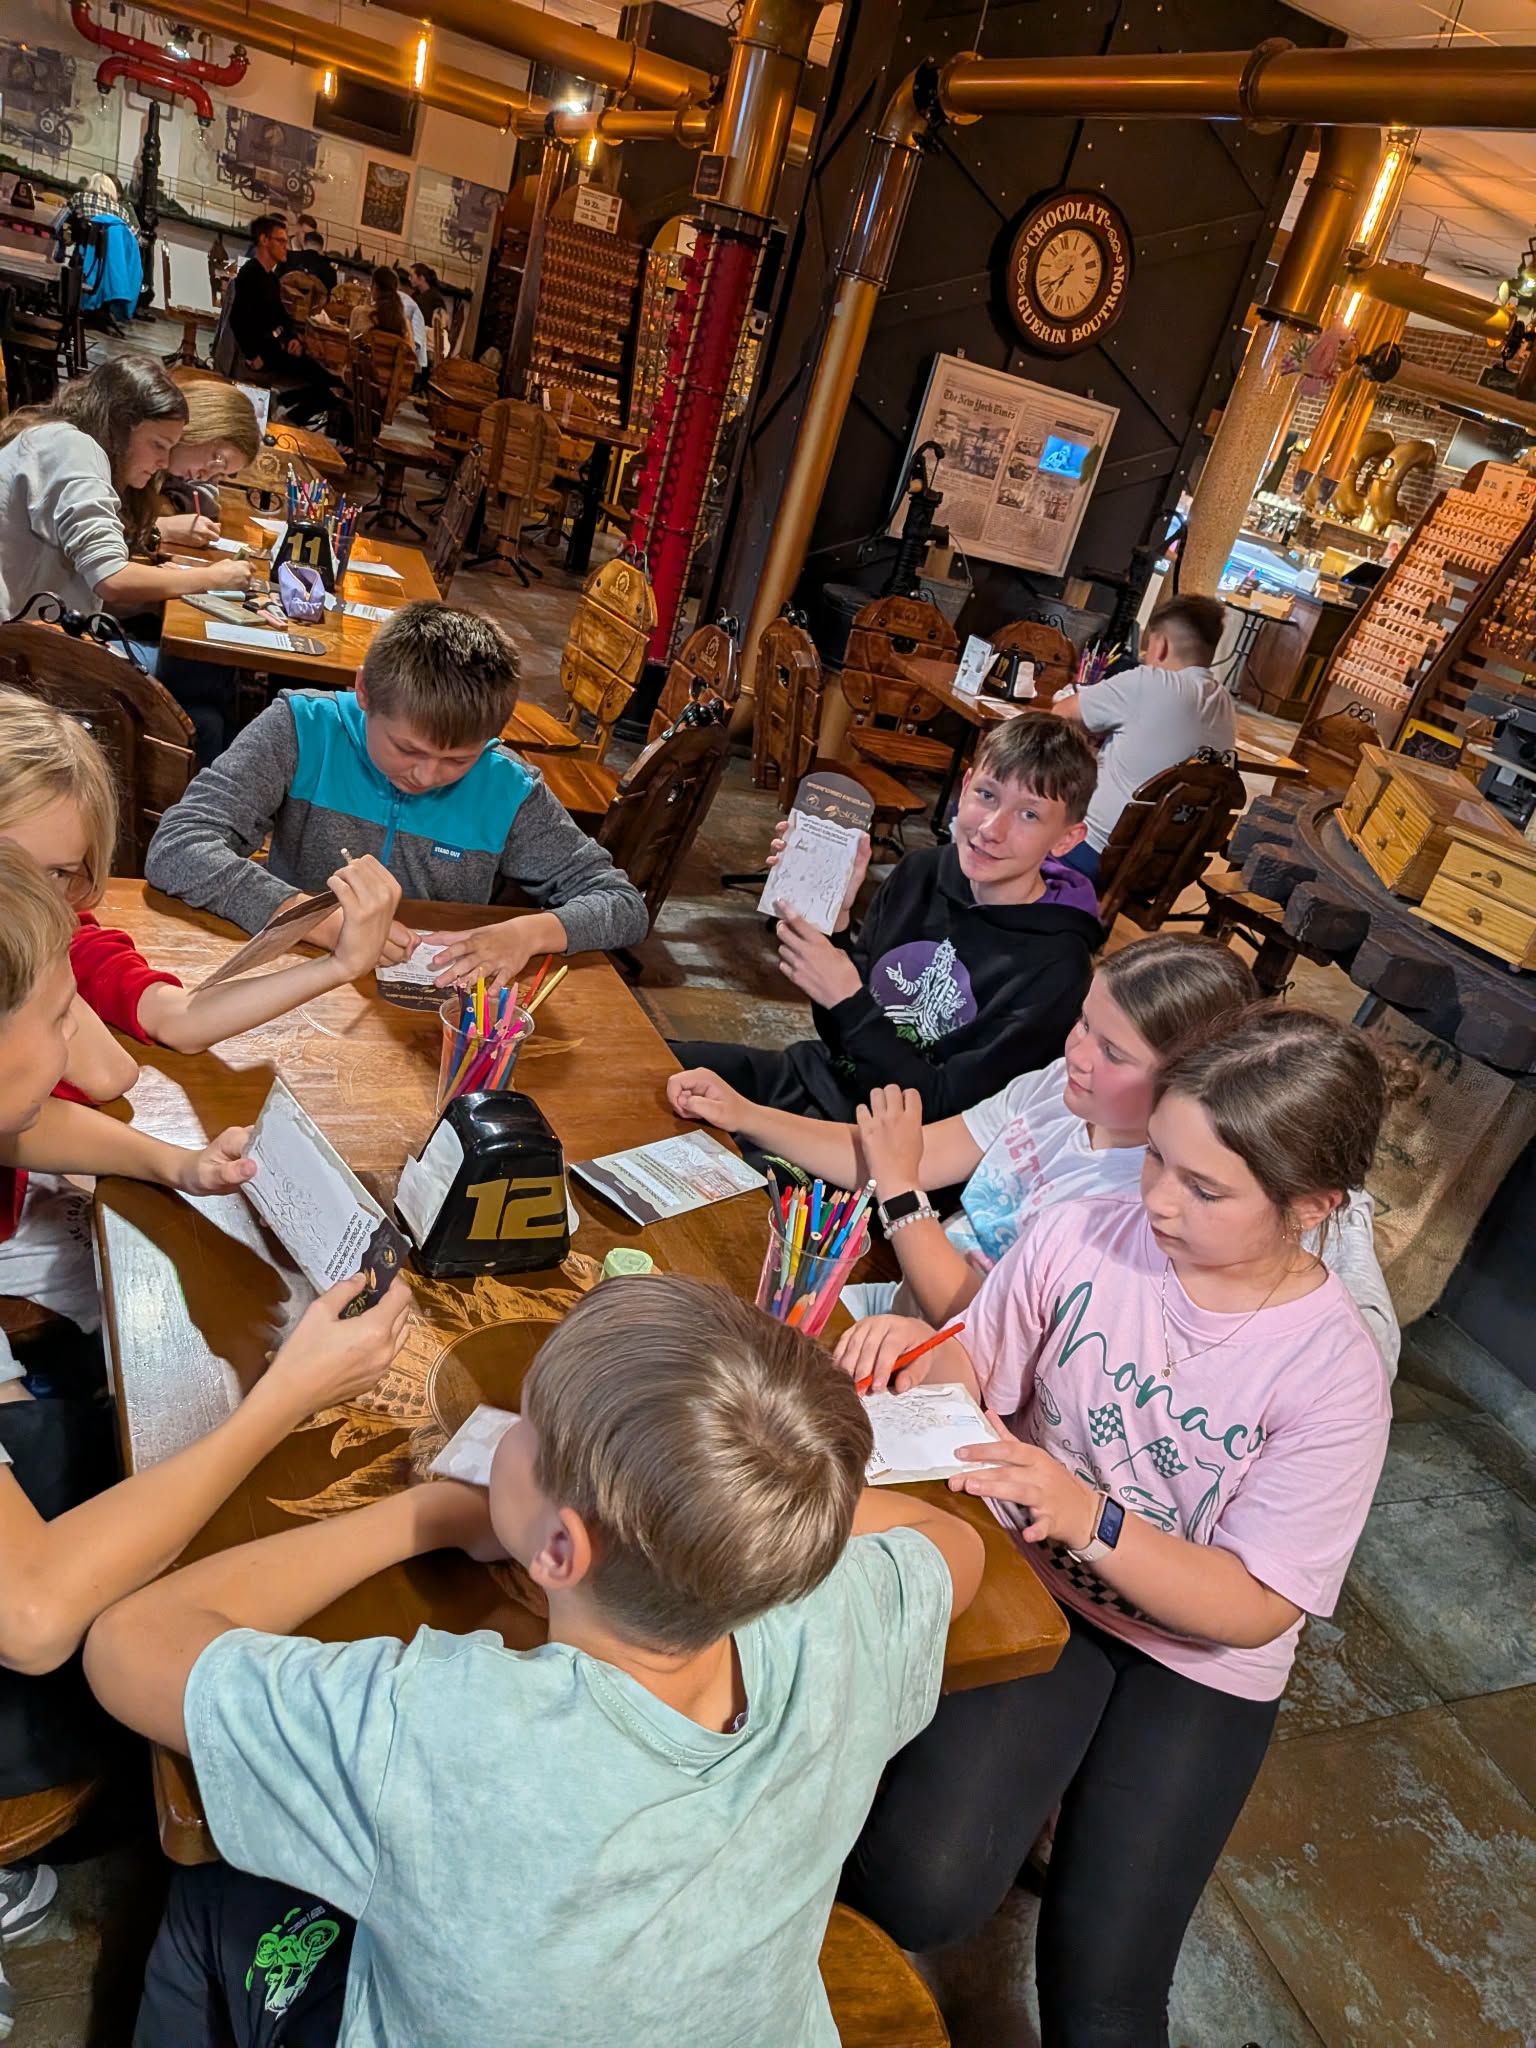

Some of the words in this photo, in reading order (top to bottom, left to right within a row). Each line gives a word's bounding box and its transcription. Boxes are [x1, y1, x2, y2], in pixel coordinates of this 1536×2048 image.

[1026, 201, 1110, 247] CHOCOLAT
[1017, 295, 1066, 344] GUERIN
[1071, 264, 1125, 343] BOUTRON
[943, 389, 957, 402] The
[992, 405, 1016, 420] Times
[287, 532, 322, 566] 11
[466, 1175, 568, 1240] 12
[1055, 1281, 1267, 1460] Monaco
